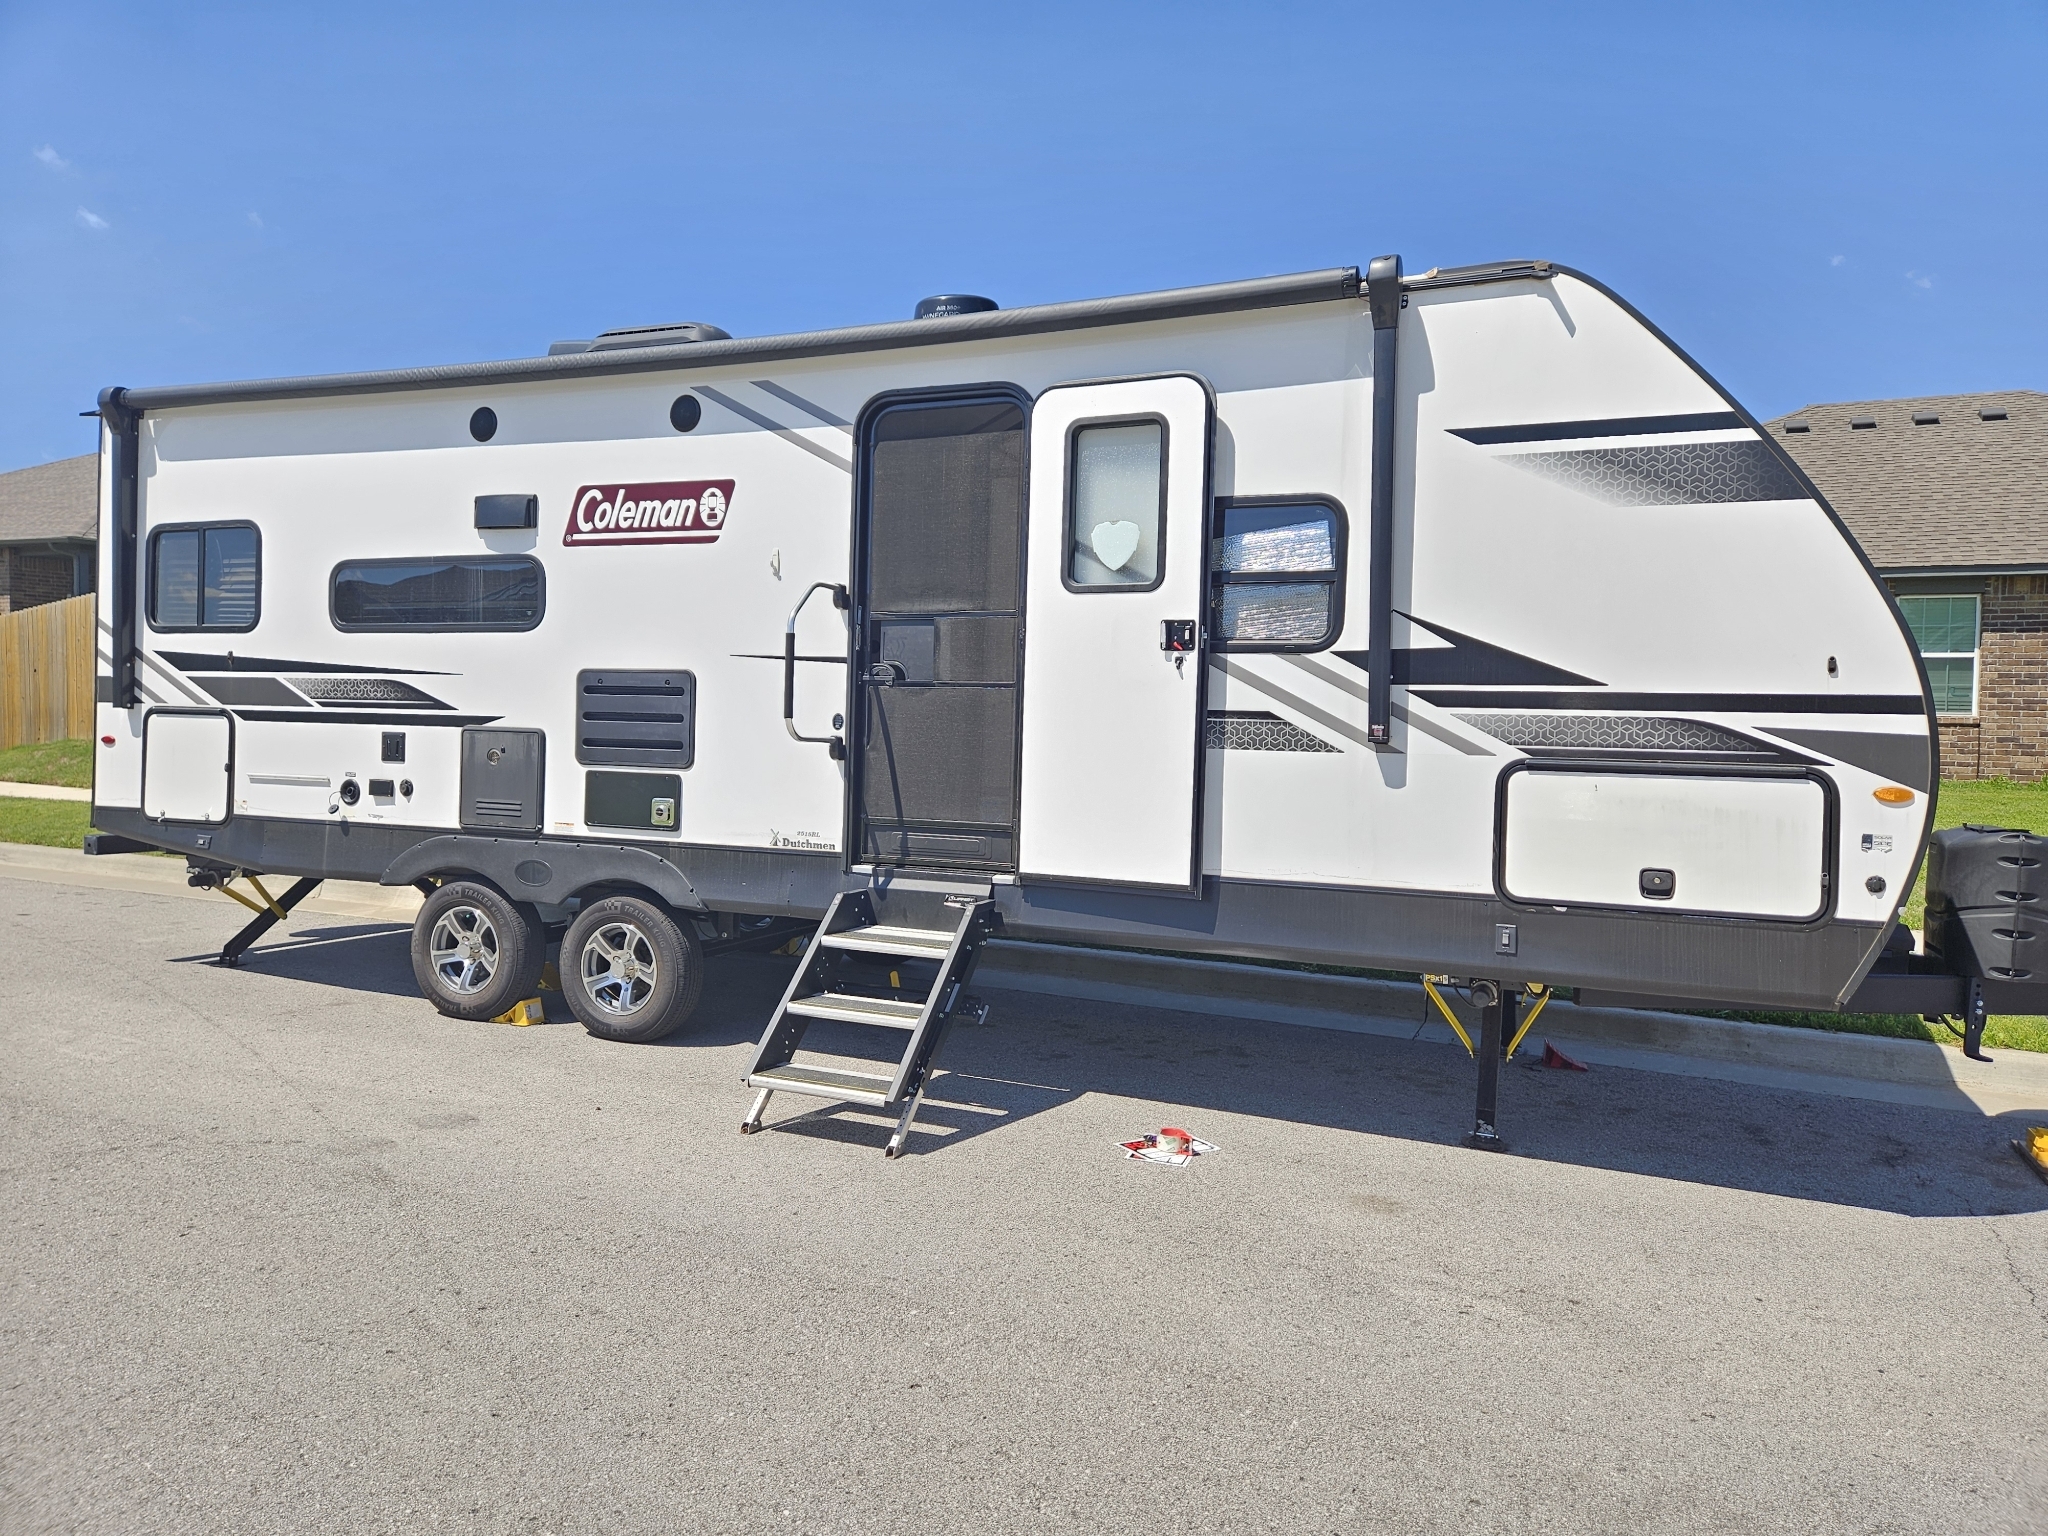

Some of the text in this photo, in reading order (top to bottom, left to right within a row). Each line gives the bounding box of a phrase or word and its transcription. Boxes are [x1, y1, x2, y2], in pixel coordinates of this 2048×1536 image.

[577, 488, 697, 532] Coleman
[782, 837, 836, 851] Dutchmen
[464, 888, 504, 925] TRAILER KING
[623, 905, 653, 929] TRAILER
[651, 925, 666, 948] KING
